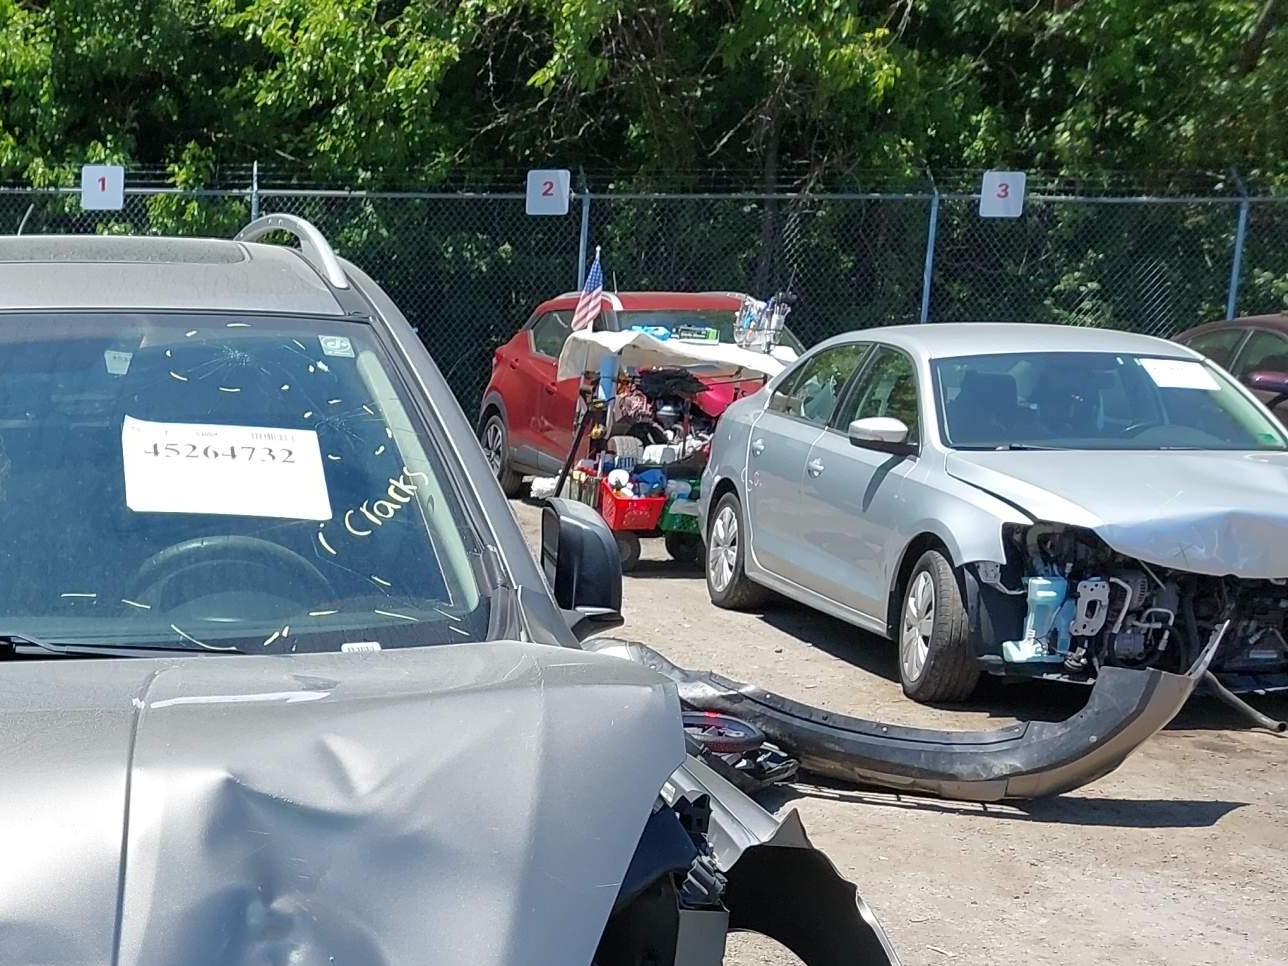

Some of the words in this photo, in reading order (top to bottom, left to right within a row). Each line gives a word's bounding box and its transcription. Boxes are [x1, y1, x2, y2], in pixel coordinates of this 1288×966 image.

[98, 175, 106, 192] 1
[542, 181, 554, 197] 2
[997, 183, 1009, 199] 3
[143, 442, 296, 464] 45264732
